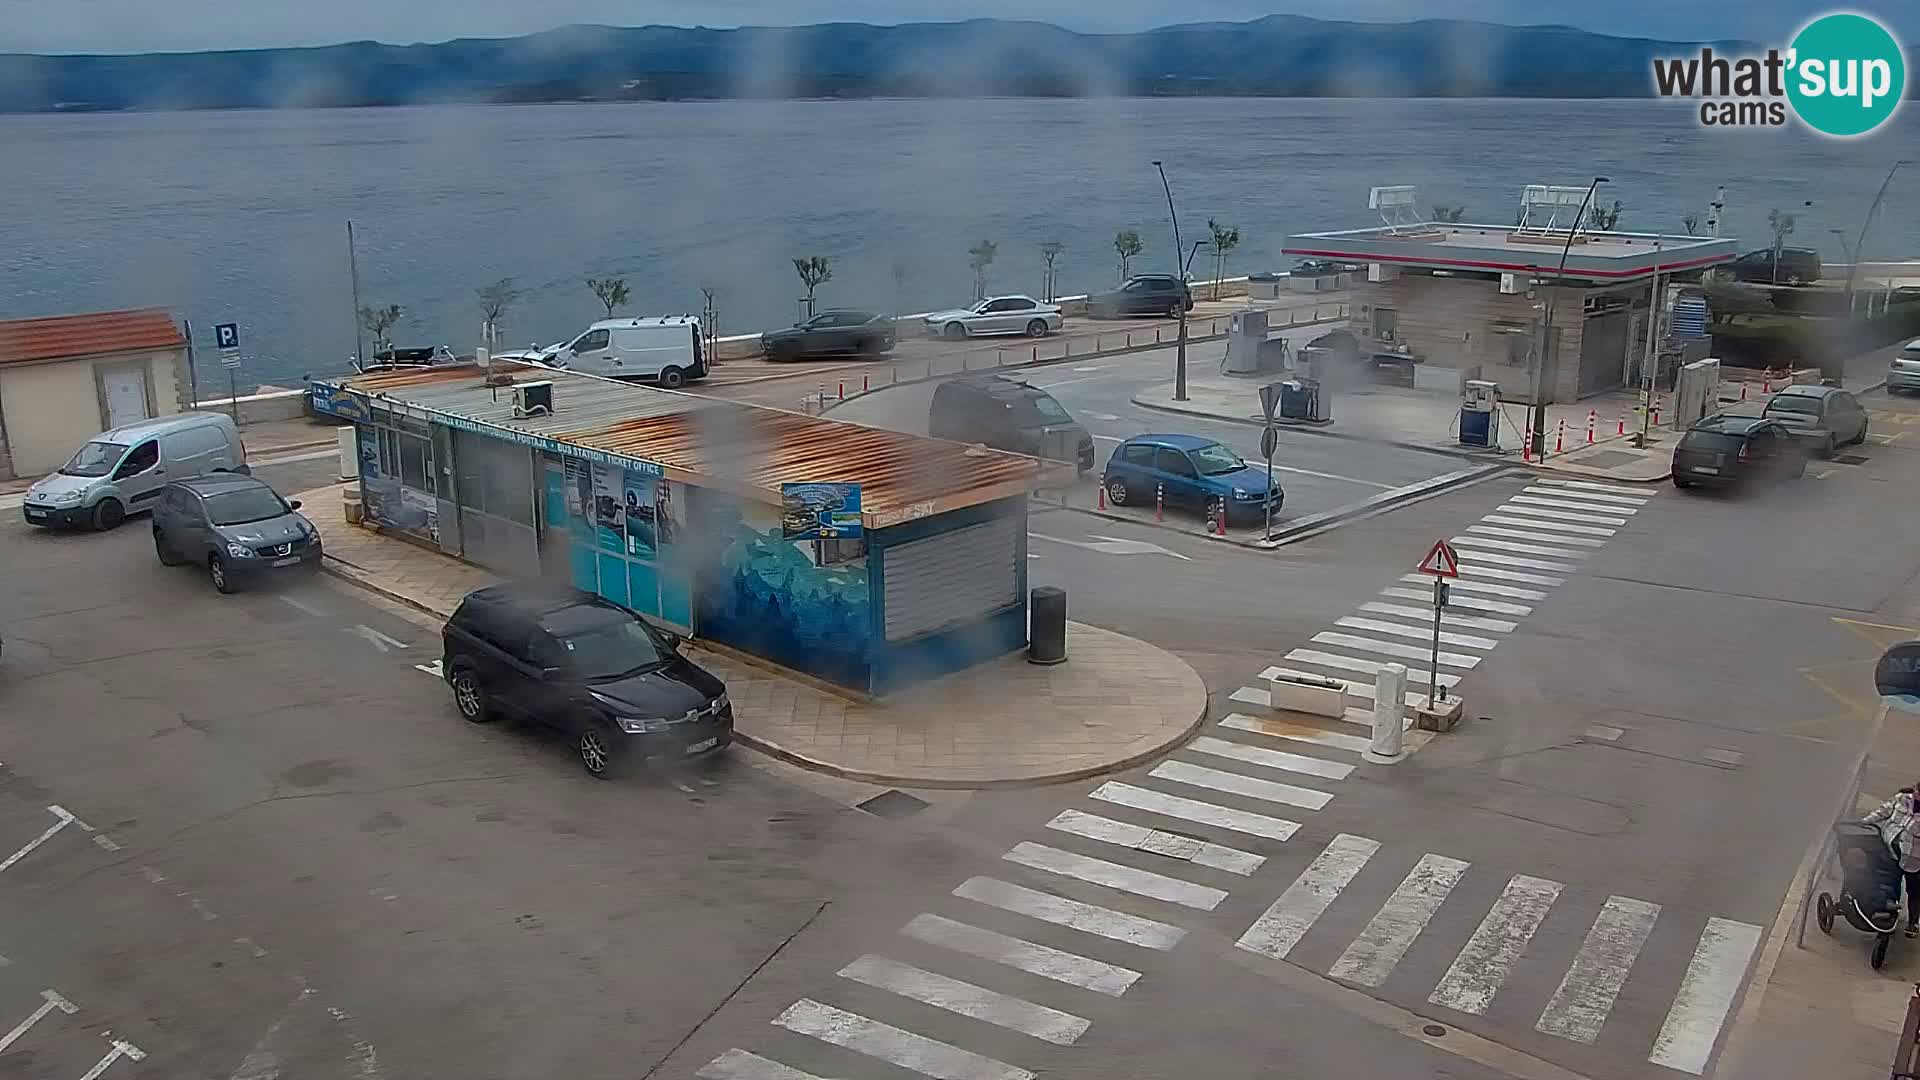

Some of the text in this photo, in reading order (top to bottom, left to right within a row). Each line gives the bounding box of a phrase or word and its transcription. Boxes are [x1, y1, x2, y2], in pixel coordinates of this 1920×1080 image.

[221, 327, 233, 345] P
[517, 434, 548, 448] POSTAJA
[557, 444, 572, 454] BUS
[573, 447, 604, 462] STATION
[607, 454, 633, 468] TICKET
[633, 461, 660, 475] OFFICE
